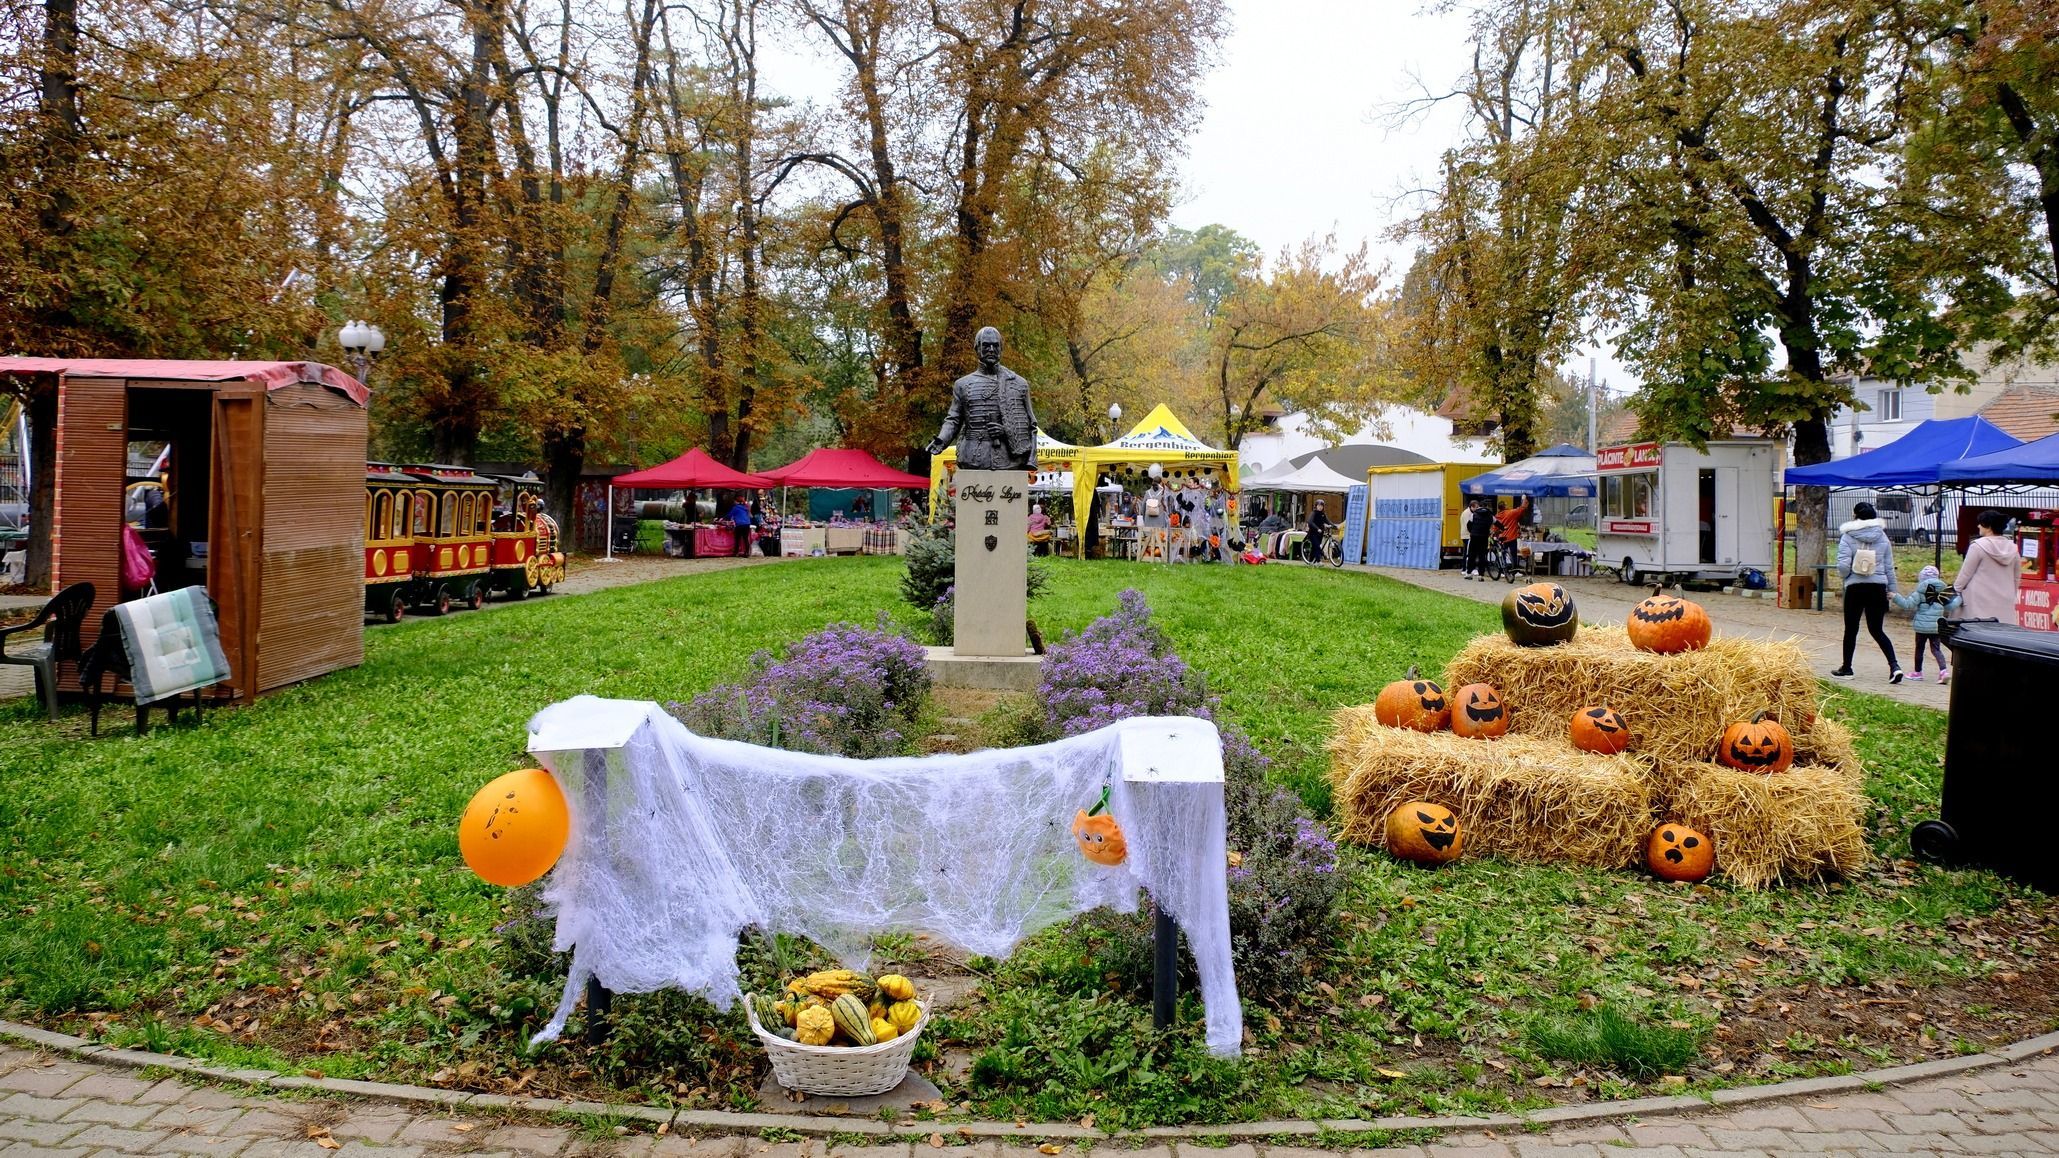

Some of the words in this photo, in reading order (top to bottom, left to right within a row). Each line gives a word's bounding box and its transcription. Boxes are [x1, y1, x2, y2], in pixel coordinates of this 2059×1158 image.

[1120, 441, 1200, 451] Bergenbier
[1036, 448, 1079, 458] ergenbier
[1185, 451, 1234, 460] Bergenbier
[2025, 589, 2049, 608] NACHOS
